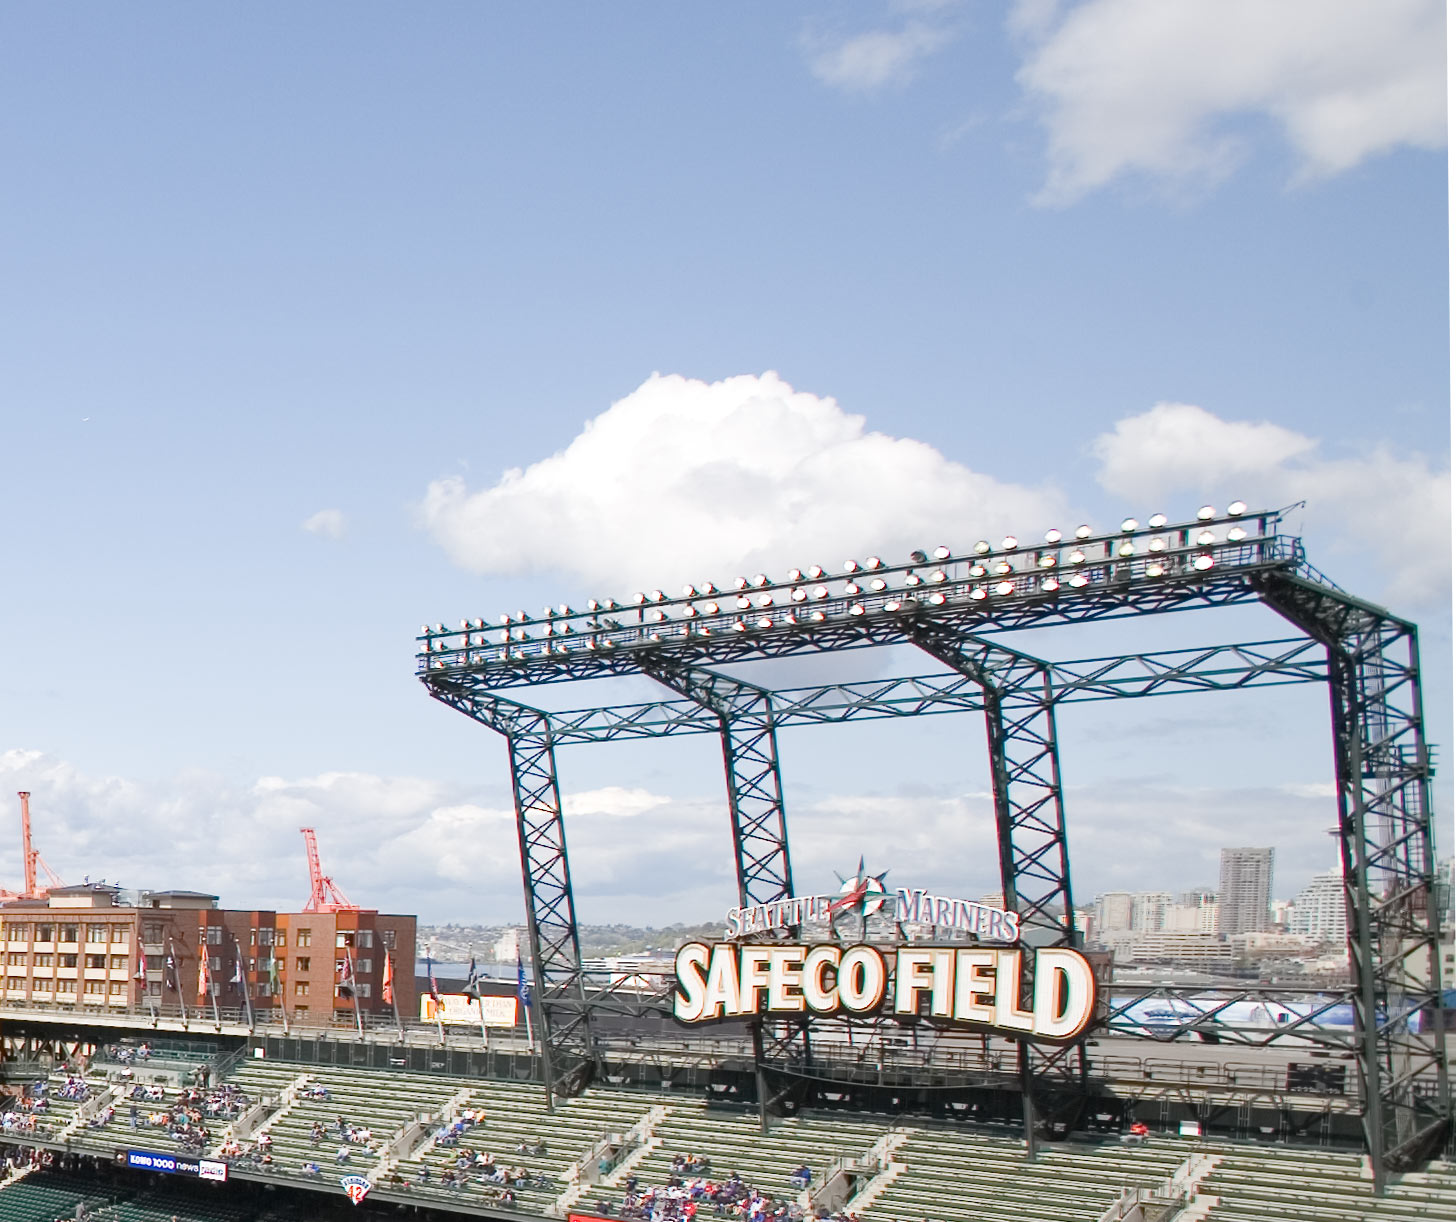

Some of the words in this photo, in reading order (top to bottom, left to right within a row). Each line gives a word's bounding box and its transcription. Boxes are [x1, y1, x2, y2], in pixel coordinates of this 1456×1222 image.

[725, 896, 830, 940] SEATTLE
[896, 887, 1019, 943] MARINERS
[674, 943, 885, 1022] SAFECO
[896, 946, 1095, 1039] FIELD
[152, 1156, 176, 1170] 1000
[346, 1185, 362, 1200] 42
